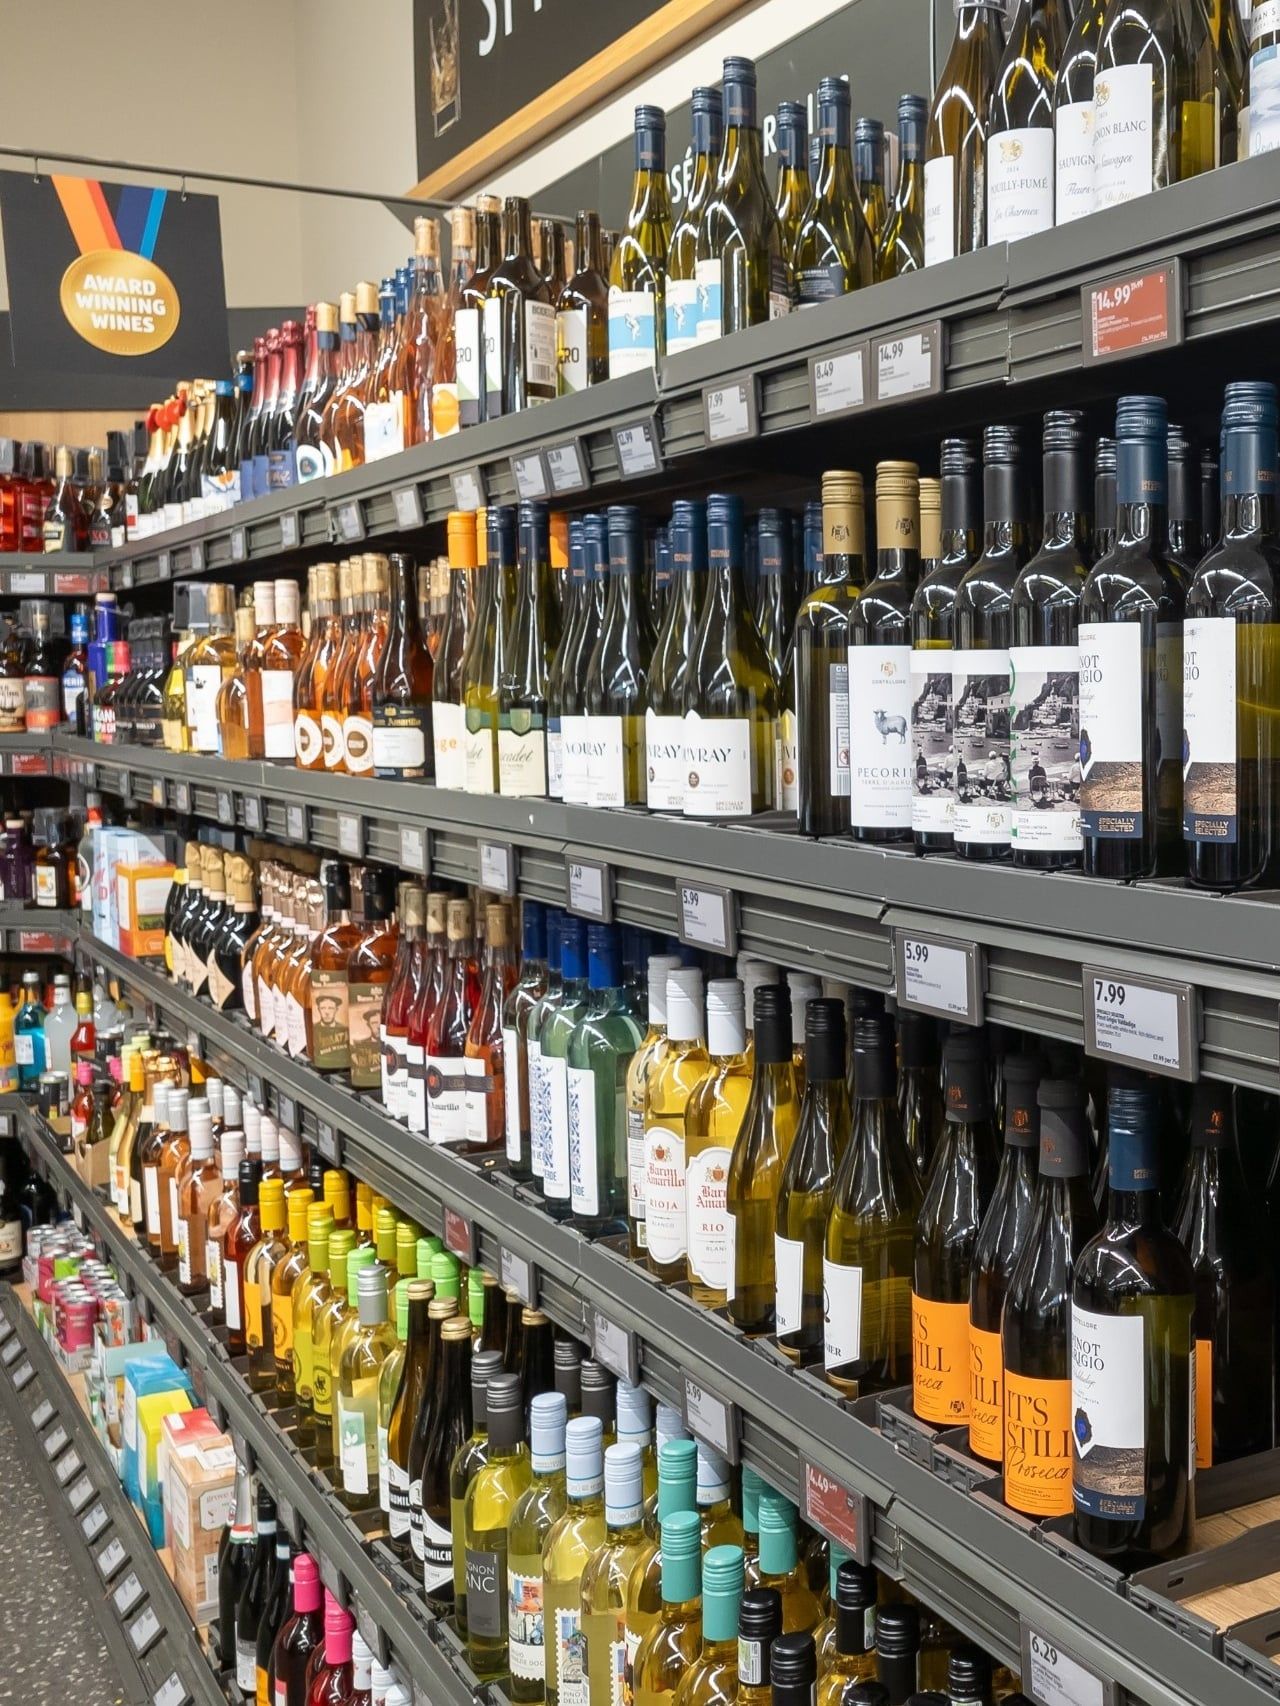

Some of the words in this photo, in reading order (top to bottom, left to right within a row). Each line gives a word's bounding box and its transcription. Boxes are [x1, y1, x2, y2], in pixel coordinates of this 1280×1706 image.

[1114, 120, 1148, 136] BLANC
[1059, 155, 1096, 171] SAUVIGN
[83, 273, 157, 296] AWARD
[75, 292, 167, 317] WINNING
[1097, 284, 1131, 311] 14.99
[91, 313, 155, 334] WINES
[880, 342, 904, 363] 14.99
[816, 361, 834, 380] 8.49
[1098, 817, 1136, 827] SPECIALLY
[1098, 824, 1135, 833] SELECTED
[1194, 820, 1229, 830] SPECIALLY
[1194, 827, 1228, 837] SELECTED
[681, 889, 699, 907] 5.99
[906, 942, 929, 963] 5.99
[1095, 980, 1126, 1006] 7.99
[649, 1198, 679, 1211] RIOJA
[685, 1380, 702, 1402] 5.99
[1007, 1389, 1048, 1427] IT'S
[809, 1469, 829, 1493] 4.49
[1031, 1636, 1058, 1666] 6.29
